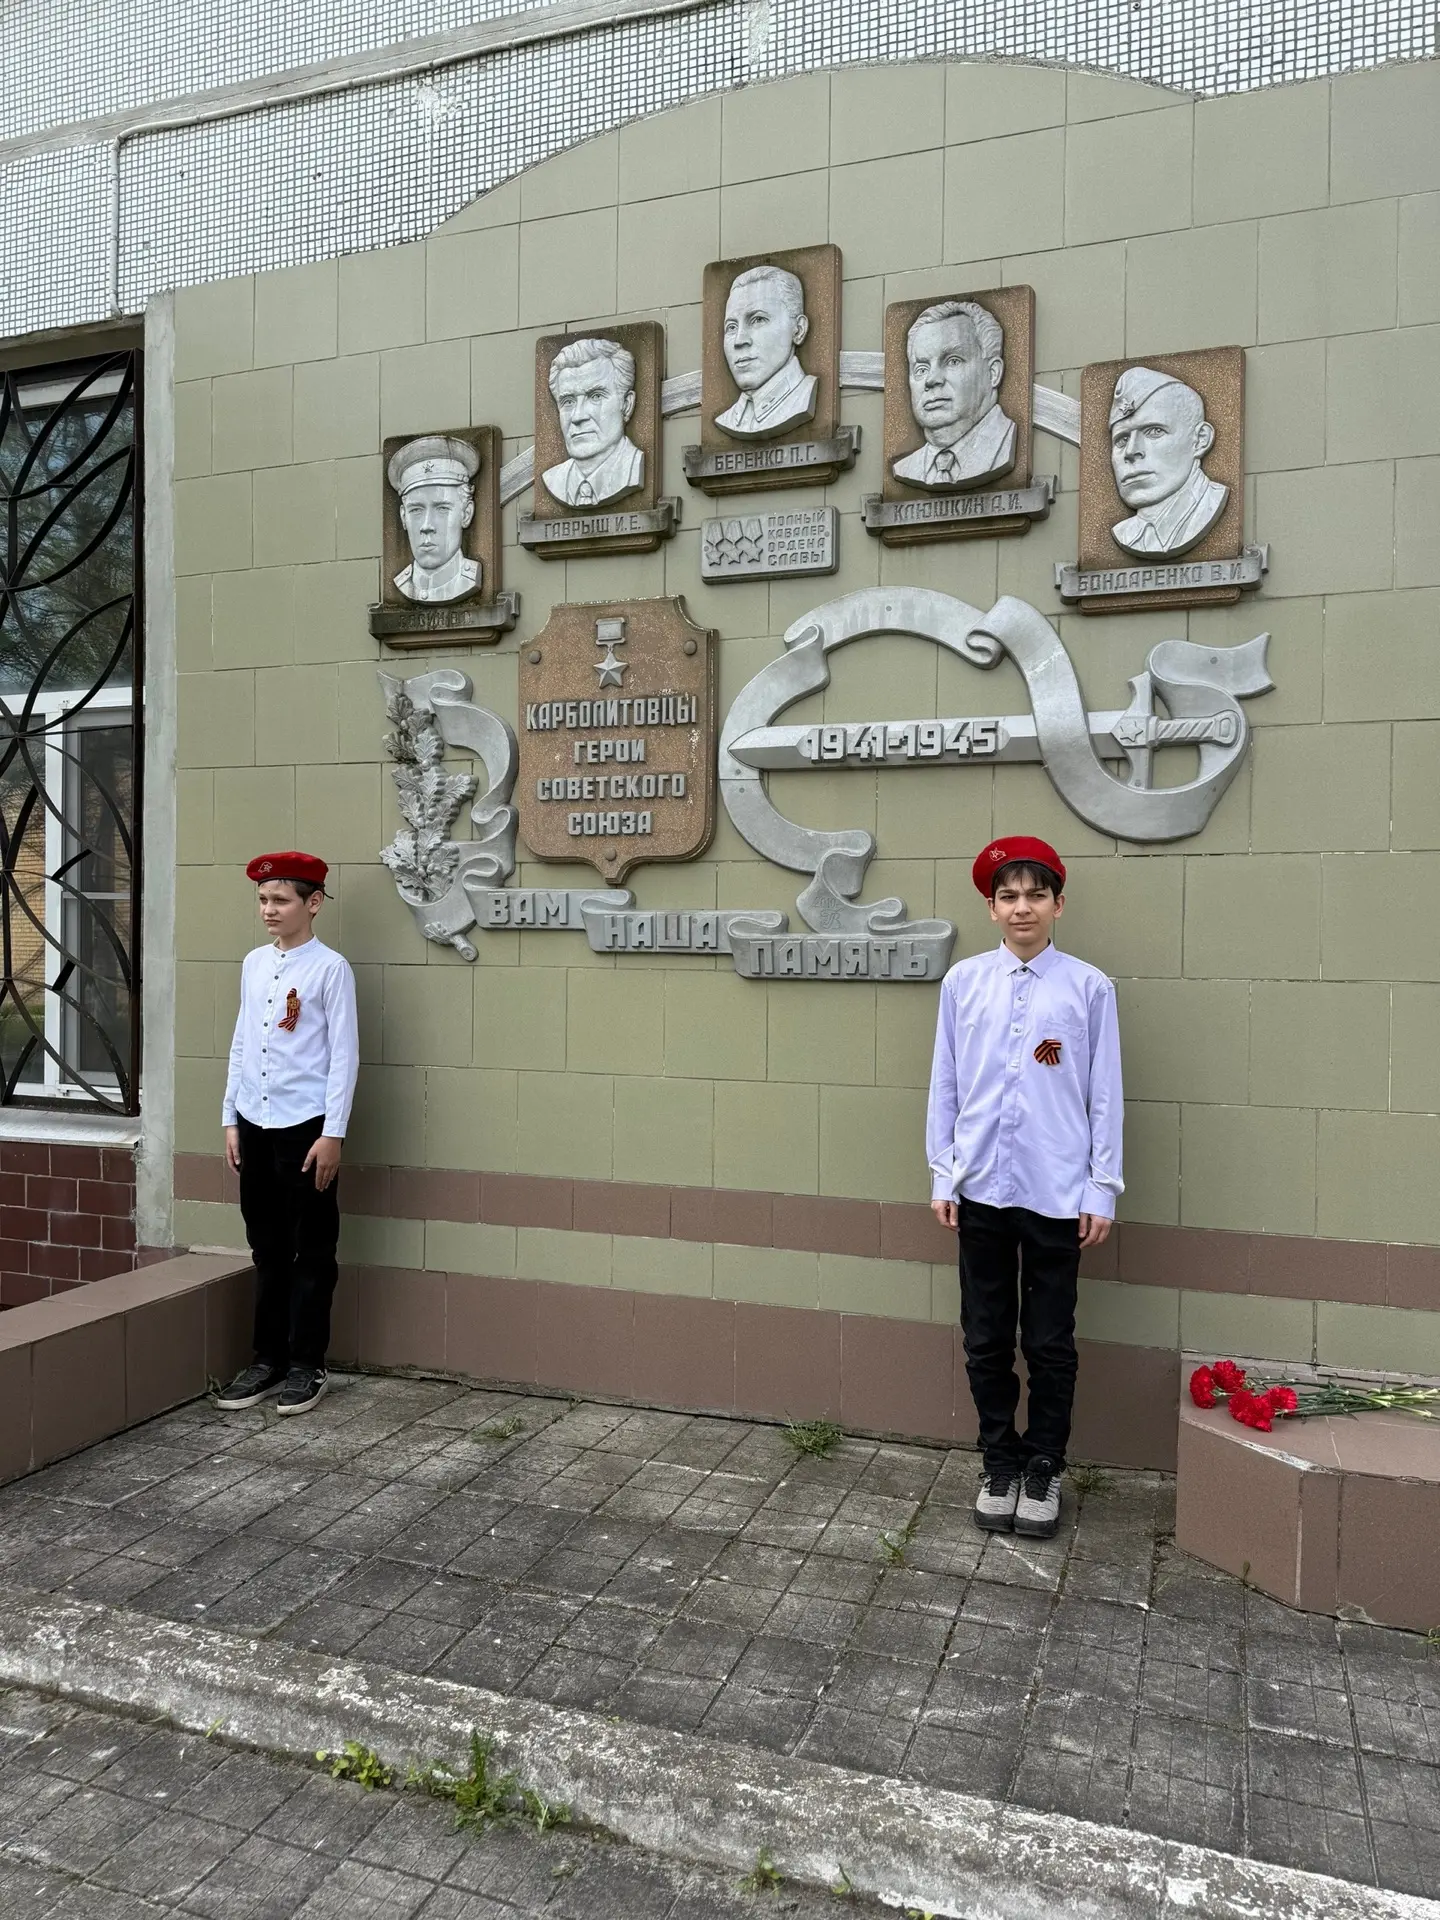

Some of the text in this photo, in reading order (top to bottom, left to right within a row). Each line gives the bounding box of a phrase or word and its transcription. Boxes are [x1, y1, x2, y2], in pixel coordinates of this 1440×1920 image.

[714, 448, 784, 472] БЕРЕНКО
[768, 509, 826, 528] ПОЛНЫЙ
[893, 496, 985, 523] КЛЮШКИН
[543, 517, 609, 538] ГАВРЫШ
[768, 524, 826, 540] КАВАЛЕР
[768, 537, 826, 553] ОРДЕНА
[768, 550, 825, 566] СЛАВЫ
[1077, 564, 1204, 593] БОНДАРЕНКО
[526, 695, 697, 731] КАРБОЛИТОВЦЫ
[573, 738, 646, 764] ГЕРОИ
[806, 720, 1000, 764] 1941-1945
[536, 773, 686, 801] СОВЕТСКОГО
[567, 810, 653, 836] СОЮЗА
[487, 891, 928, 978] ВАМ НАША ПАМЯТЬ
